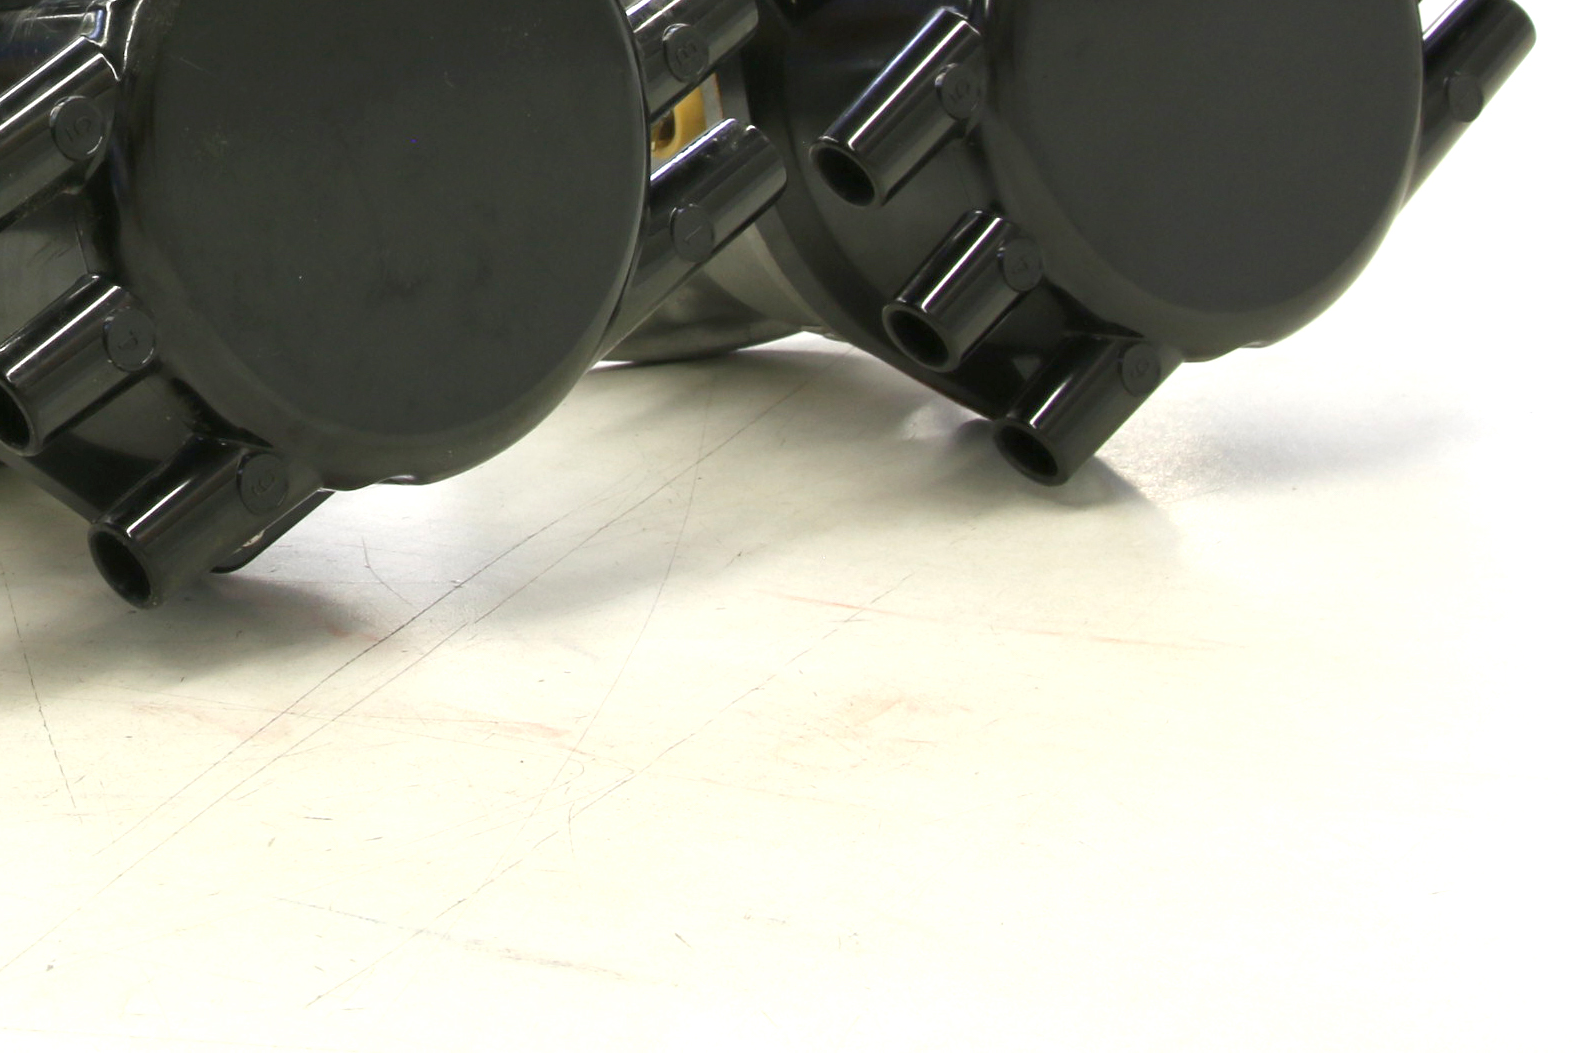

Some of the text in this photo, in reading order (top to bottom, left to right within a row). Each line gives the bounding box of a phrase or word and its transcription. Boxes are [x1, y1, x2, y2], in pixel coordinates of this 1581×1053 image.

[674, 38, 699, 66] 3
[949, 78, 971, 104] 5
[64, 116, 93, 143] 5
[682, 224, 704, 246] 1
[251, 469, 277, 496] 6
